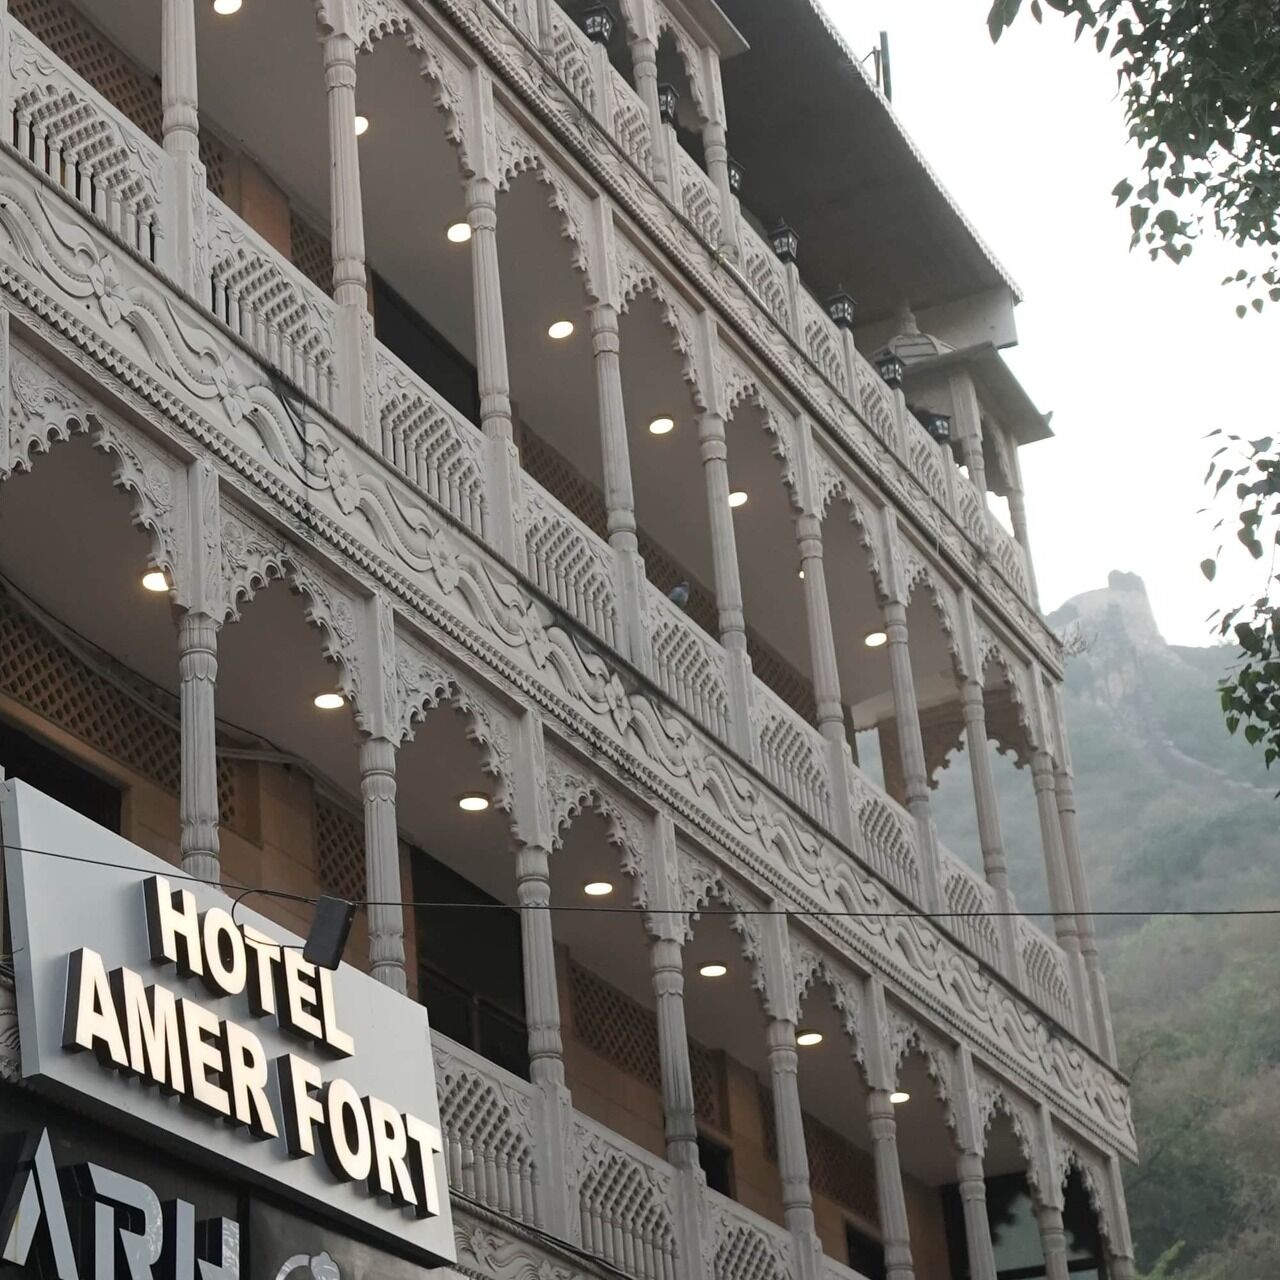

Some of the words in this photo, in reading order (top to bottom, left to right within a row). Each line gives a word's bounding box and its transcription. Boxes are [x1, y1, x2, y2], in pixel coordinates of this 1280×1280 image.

[144, 875, 355, 1058] HOTEL
[66, 947, 279, 1139] AMER
[280, 1053, 441, 1217] FORT
